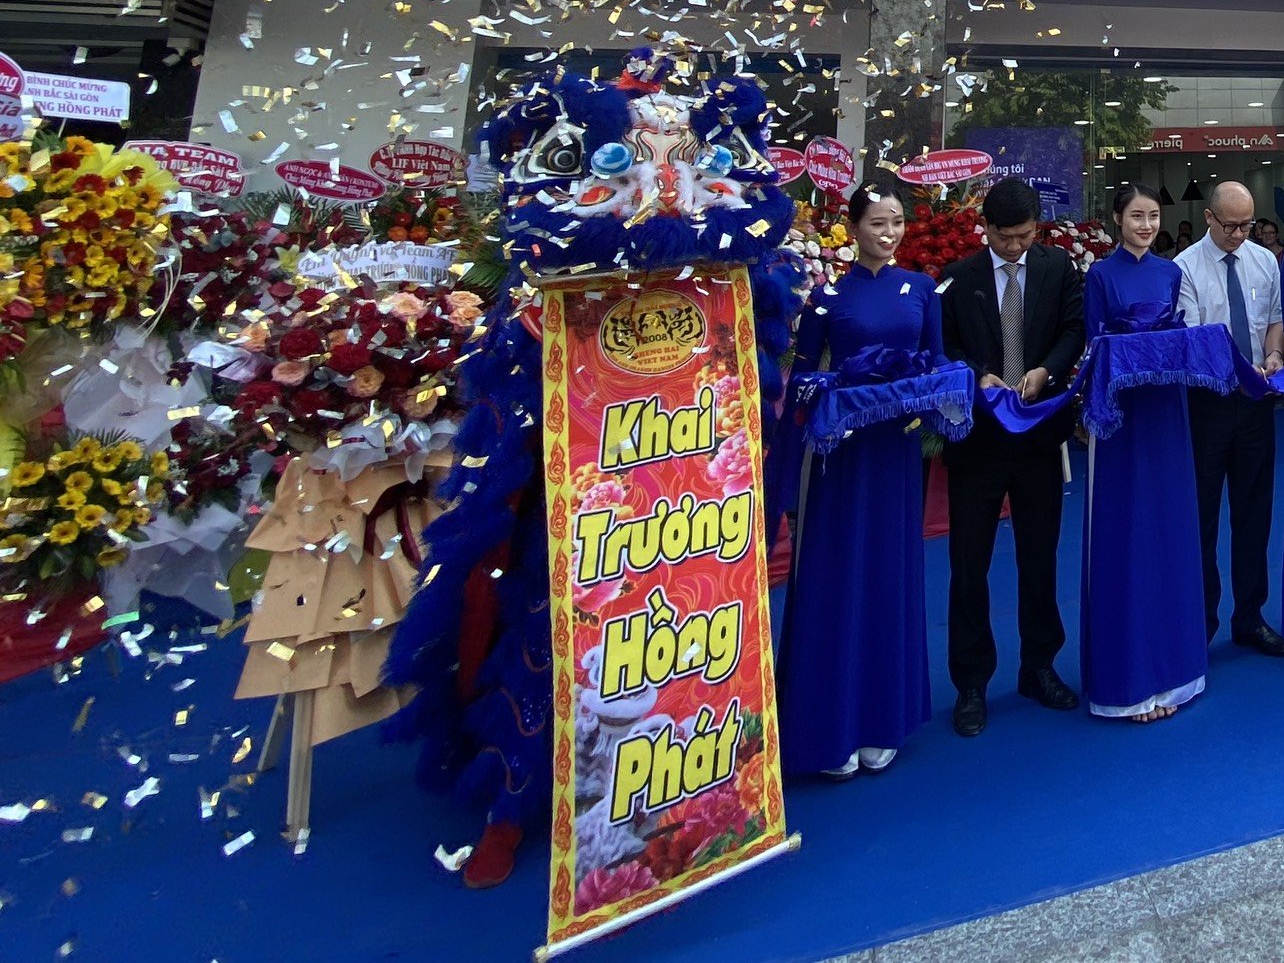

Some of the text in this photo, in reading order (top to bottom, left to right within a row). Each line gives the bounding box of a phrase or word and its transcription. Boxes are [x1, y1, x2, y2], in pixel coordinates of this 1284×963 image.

[0, 73, 19, 92] ng
[93, 105, 123, 118] PHÁT
[174, 147, 235, 167] TEAM
[1011, 163, 1025, 174] tôi
[601, 387, 714, 469] Khai
[577, 491, 751, 584] Trương
[600, 587, 741, 699] Hồng
[610, 698, 742, 823] Phát
